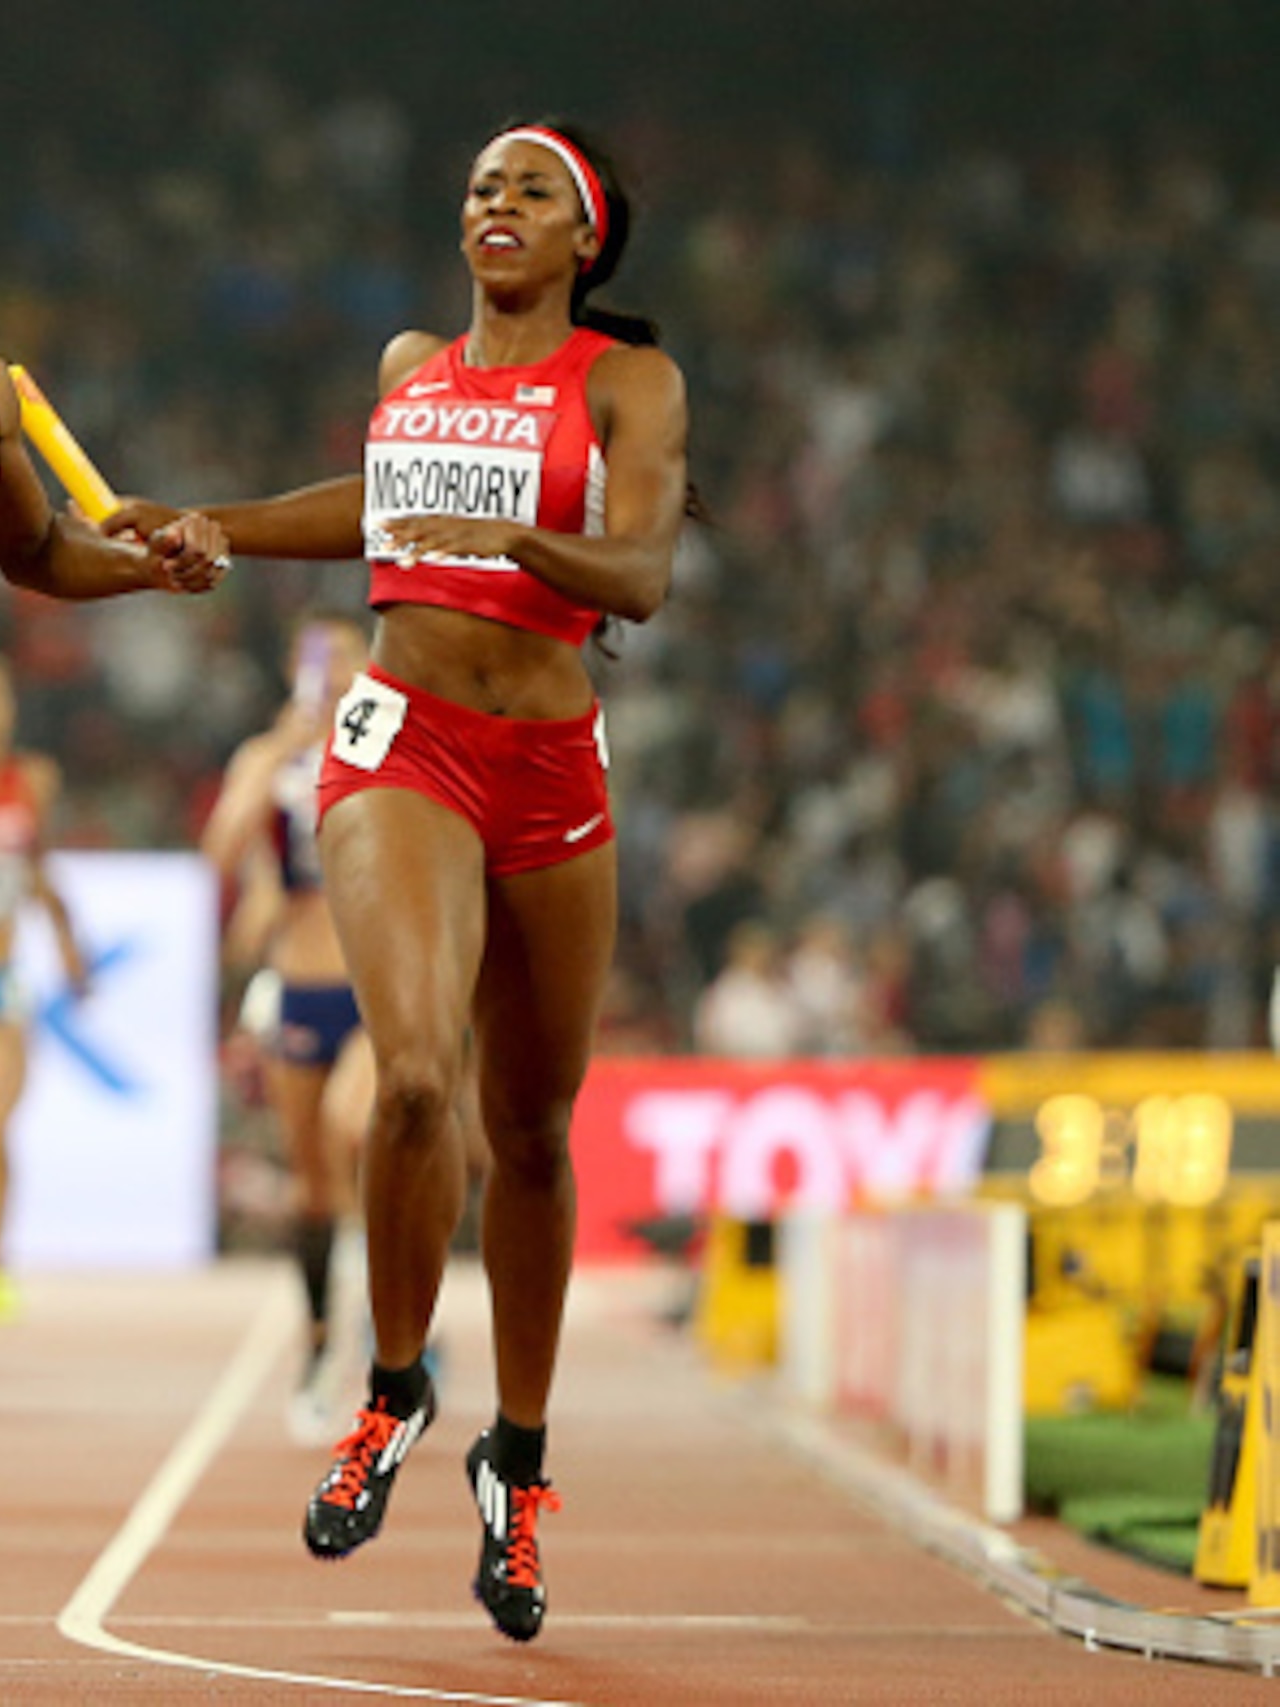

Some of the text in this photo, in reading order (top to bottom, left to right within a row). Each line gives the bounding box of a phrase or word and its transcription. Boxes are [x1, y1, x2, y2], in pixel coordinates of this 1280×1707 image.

[383, 406, 538, 446] TOYOTA
[372, 460, 529, 518] McCORORY
[339, 698, 379, 746] 4
